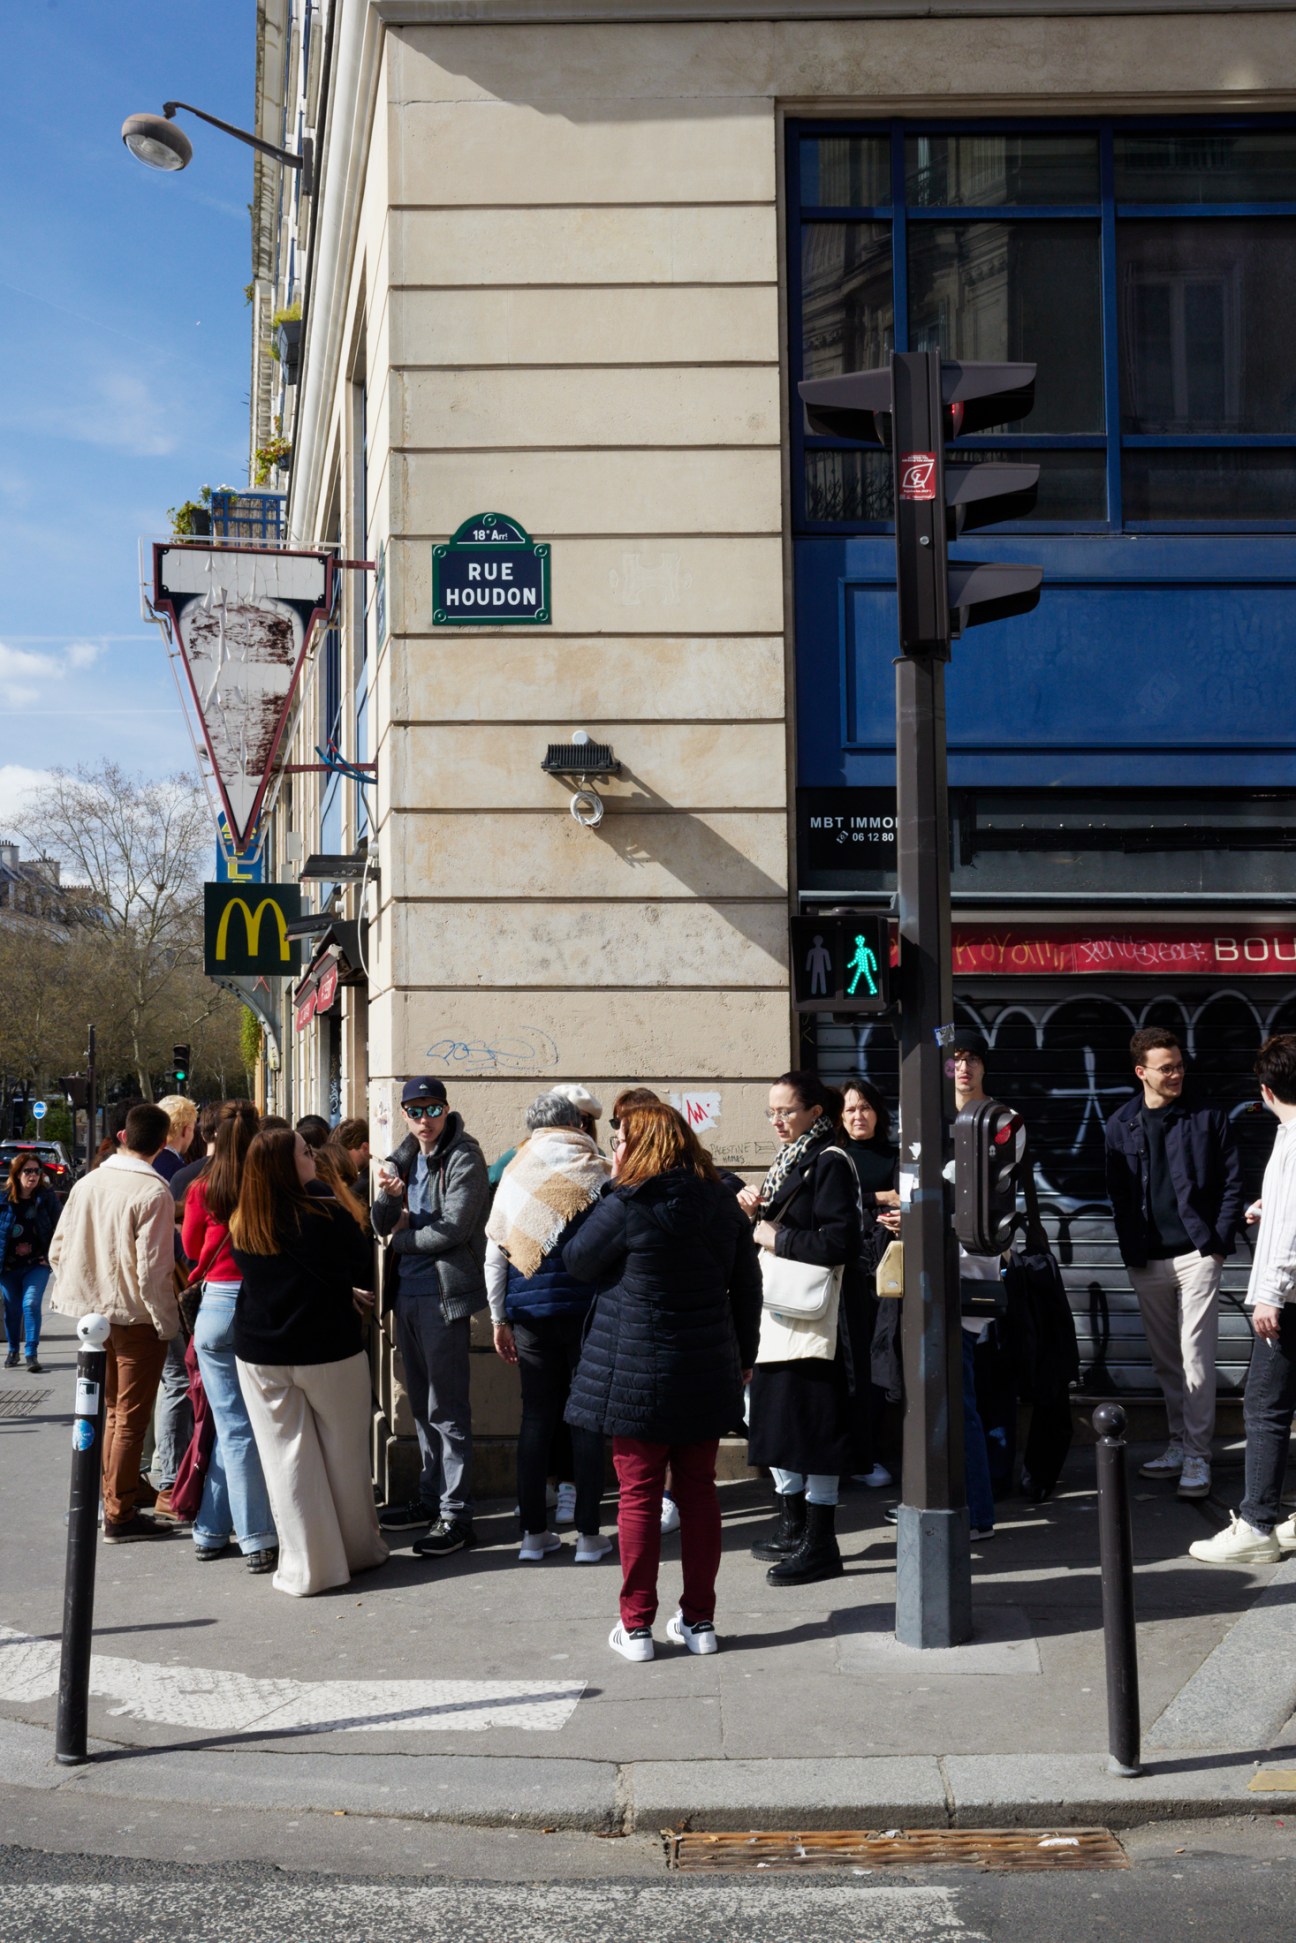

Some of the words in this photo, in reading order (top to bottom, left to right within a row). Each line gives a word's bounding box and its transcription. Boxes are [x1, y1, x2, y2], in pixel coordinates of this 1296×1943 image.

[468, 562, 513, 581] RUE
[446, 587, 536, 606] HOUDON
[810, 816, 844, 829] MBT
[852, 832, 865, 842] 06
[867, 832, 880, 842] 12
[881, 832, 895, 842] 80
[1213, 937, 1296, 961] BOU
